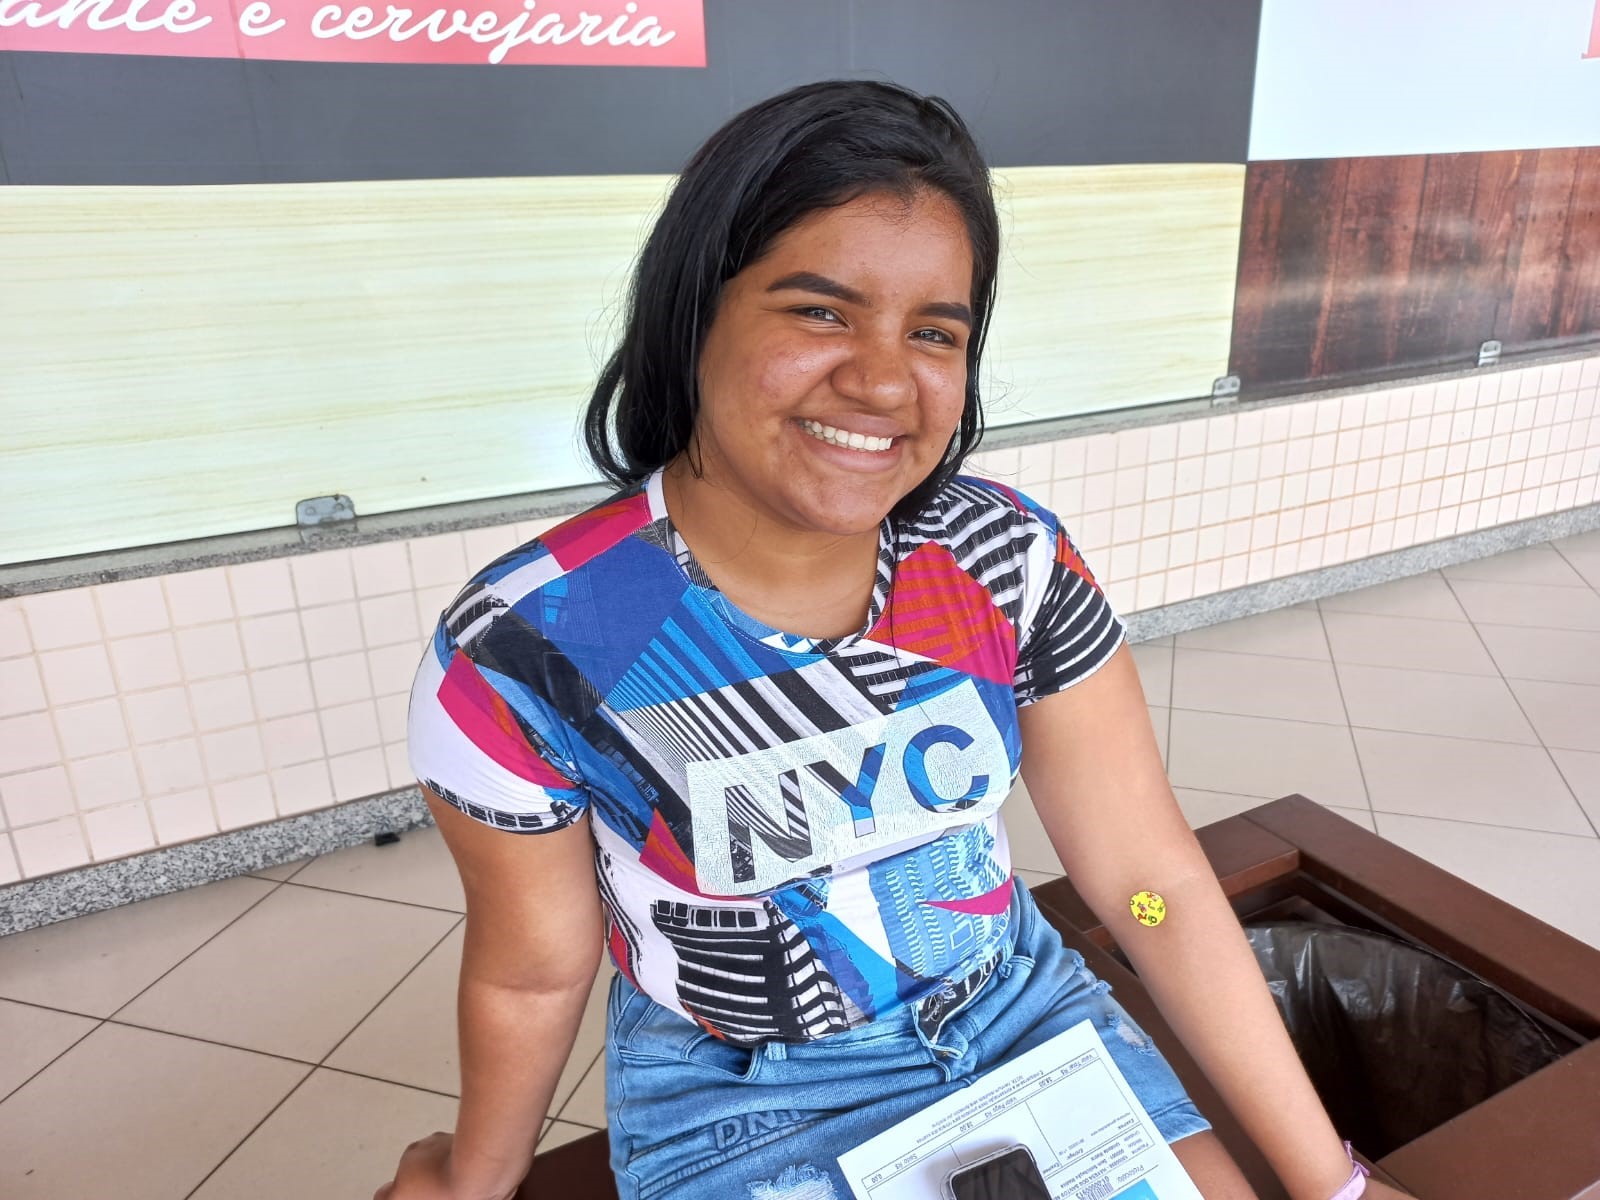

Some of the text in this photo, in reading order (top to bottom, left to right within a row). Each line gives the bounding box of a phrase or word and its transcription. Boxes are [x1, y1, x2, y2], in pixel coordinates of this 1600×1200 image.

[239, 0, 286, 36] e
[311, 0, 676, 64] cervejaria
[724, 724, 990, 884] NYC
